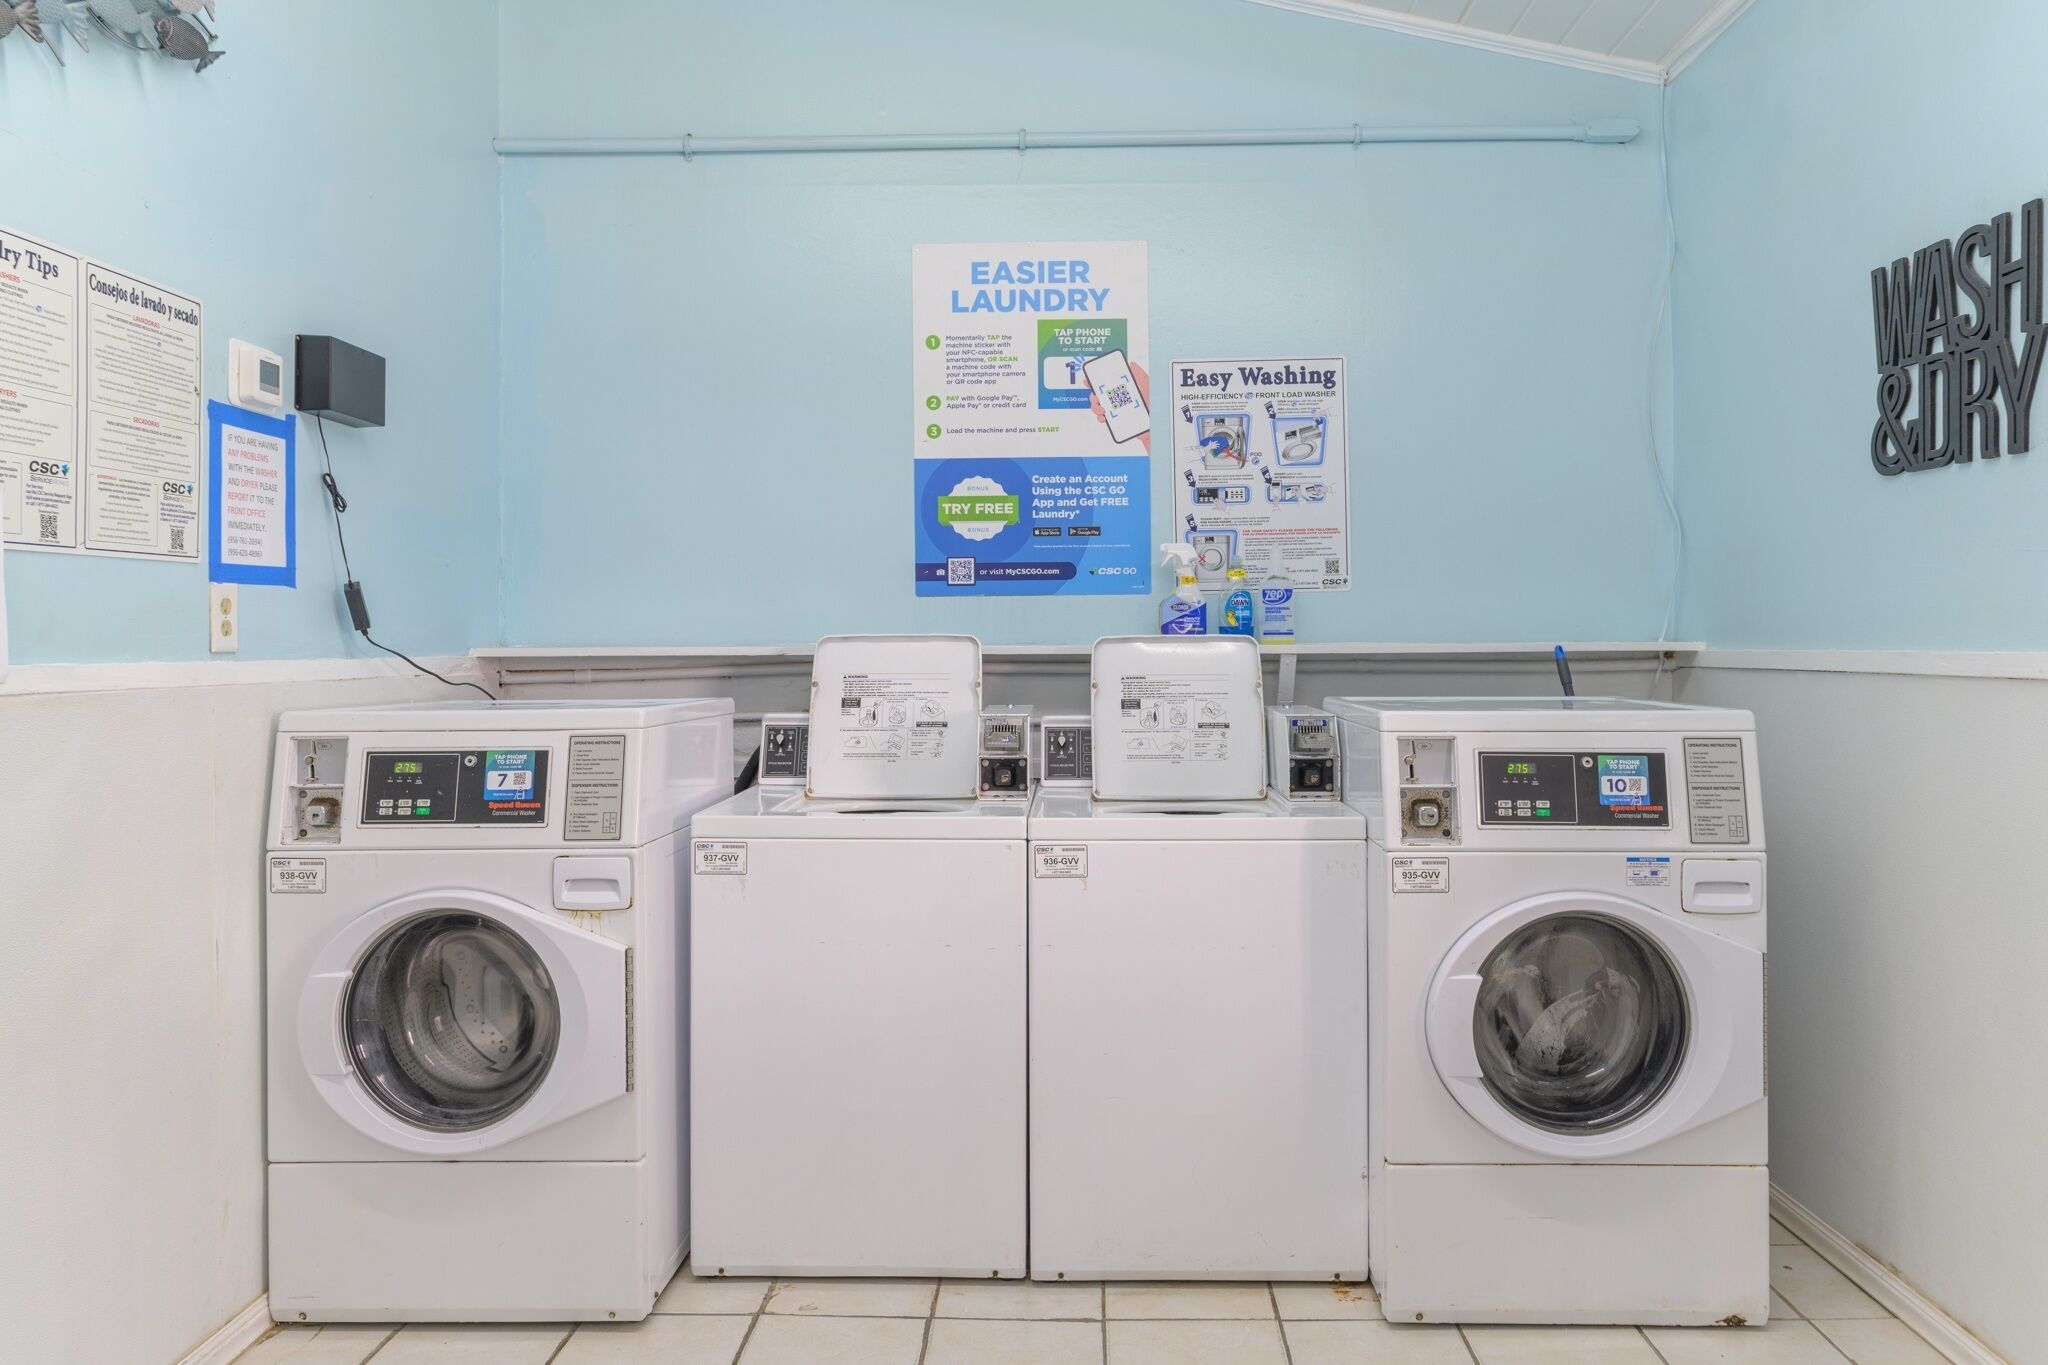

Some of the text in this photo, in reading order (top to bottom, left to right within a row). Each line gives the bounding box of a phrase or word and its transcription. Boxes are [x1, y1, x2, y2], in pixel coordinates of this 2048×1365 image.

[25, 250, 59, 280] Tips
[0, 271, 21, 283] SHERS
[971, 260, 1090, 285] EASIER
[1871, 198, 2043, 374] WASH
[89, 273, 199, 326] Consejos de lavado y secado
[951, 288, 1110, 313] LAUNDRY
[132, 314, 160, 329] LAVADORAS
[1054, 328, 1111, 337] TAP PHONE
[1058, 336, 1107, 345] TO START
[1065, 361, 1076, 384] 1
[1180, 365, 1337, 392] Easy Washing
[976, 395, 1000, 403] Google
[1181, 392, 1244, 400] HIGH-EFFICIENCY
[1255, 391, 1281, 399] FRONT
[1304, 390, 1337, 398] WASHER
[946, 402, 966, 410] Apple
[132, 416, 160, 428] SECADORAS
[227, 433, 279, 452] IF YOU ARE HAVING
[228, 447, 269, 464] ANY PROBLEMS
[29, 460, 60, 475] CSC
[227, 462, 278, 479] WITH THE WASHER
[228, 477, 278, 492] AND DRYER PLEASE
[1032, 474, 1067, 483] Create
[1085, 474, 1128, 483] Account
[162, 481, 186, 494] CSC
[1032, 486, 1125, 496] Using the CSC GO
[227, 491, 275, 506] REPORT IT TO THE
[1032, 497, 1129, 508] App and Get FREE
[227, 505, 266, 518] FRONT OFFICE
[942, 503, 1014, 514] TRY FREE
[1005, 568, 1060, 576] MyCSCGO.com
[1098, 567, 1137, 575] CSC GO
[497, 773, 508, 788] 7
[1606, 778, 1627, 793] 10
[488, 801, 514, 809] Speed
[703, 854, 739, 862] 937-GVV
[1043, 857, 1079, 865] 936-GVV
[280, 871, 318, 880] 938-GVV
[1402, 871, 1441, 880] 935-GVV
